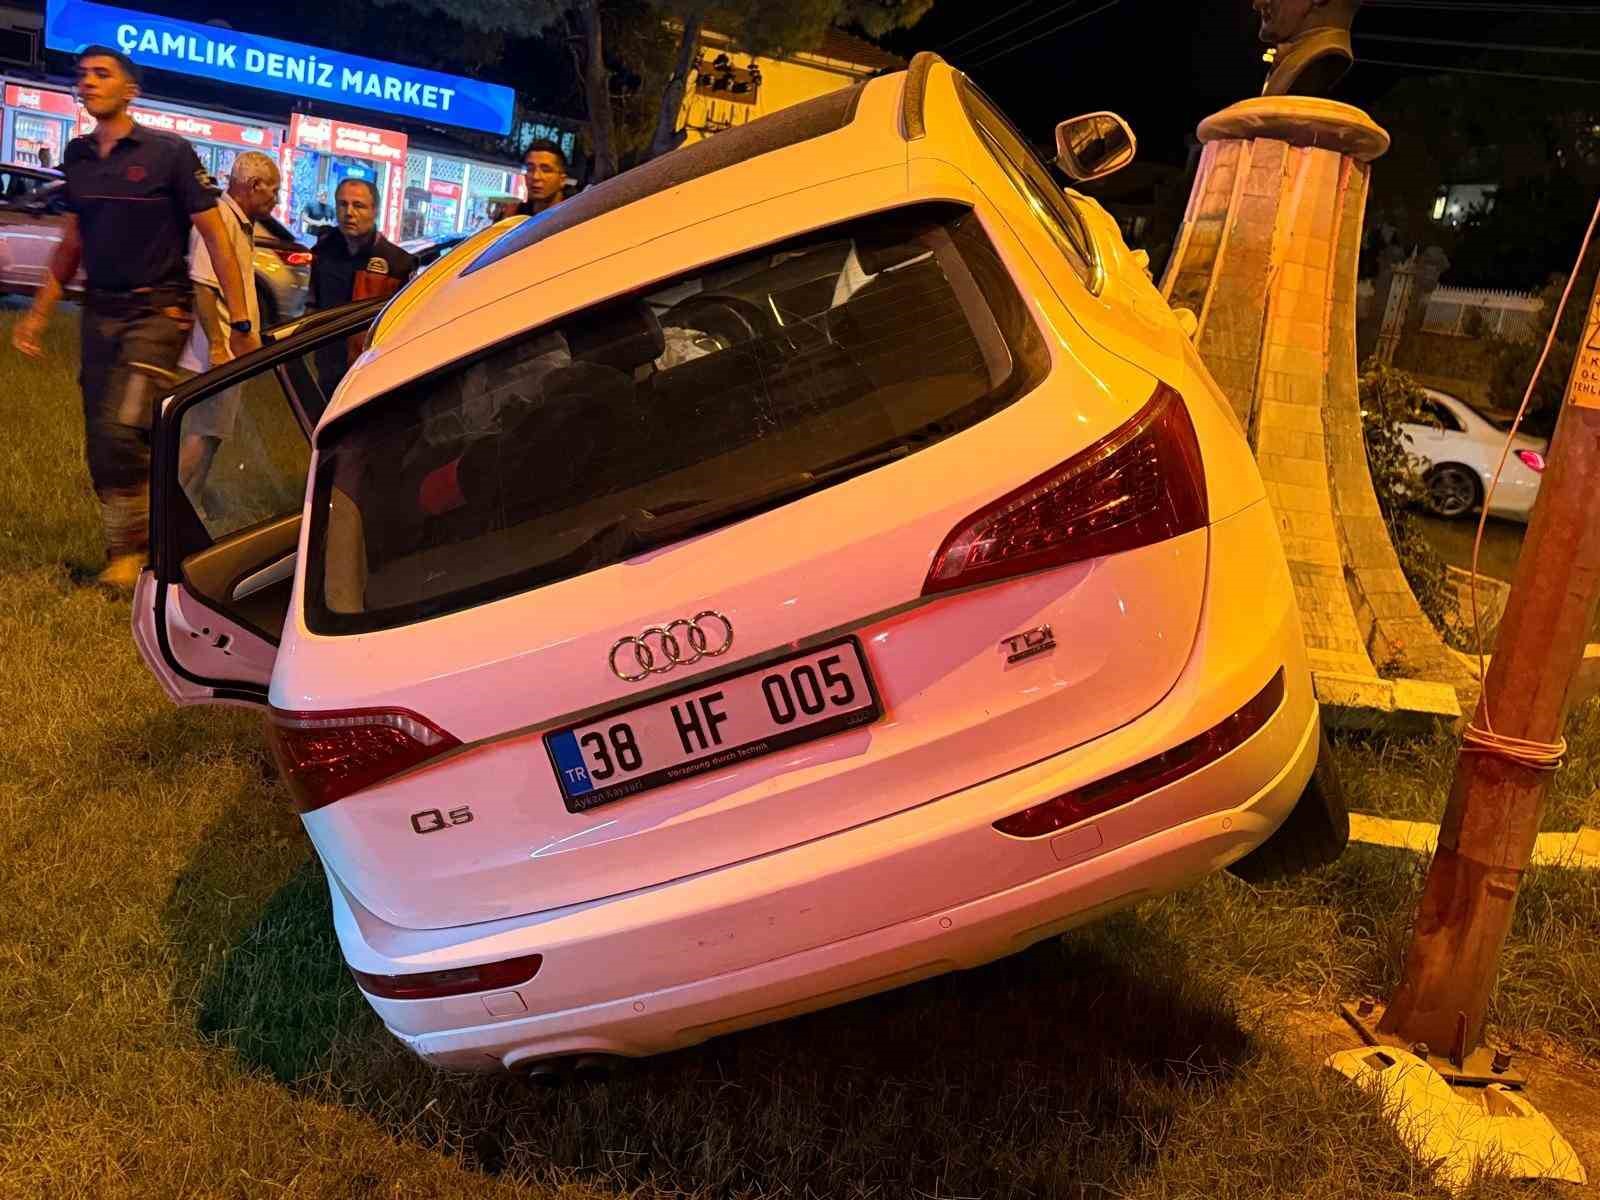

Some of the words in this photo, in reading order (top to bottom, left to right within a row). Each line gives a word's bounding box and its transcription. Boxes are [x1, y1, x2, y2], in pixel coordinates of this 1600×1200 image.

[117, 24, 237, 69] ÇAMLIK
[244, 47, 334, 88] DENİZ
[341, 67, 455, 111] MARKET
[581, 722, 643, 781] 38
[671, 690, 728, 754] HF
[761, 655, 856, 725] 005
[565, 765, 589, 785] TR
[666, 759, 711, 779] Vorsprung
[712, 750, 737, 766] durch
[737, 741, 769, 762] Technik
[410, 804, 474, 834] Q5
